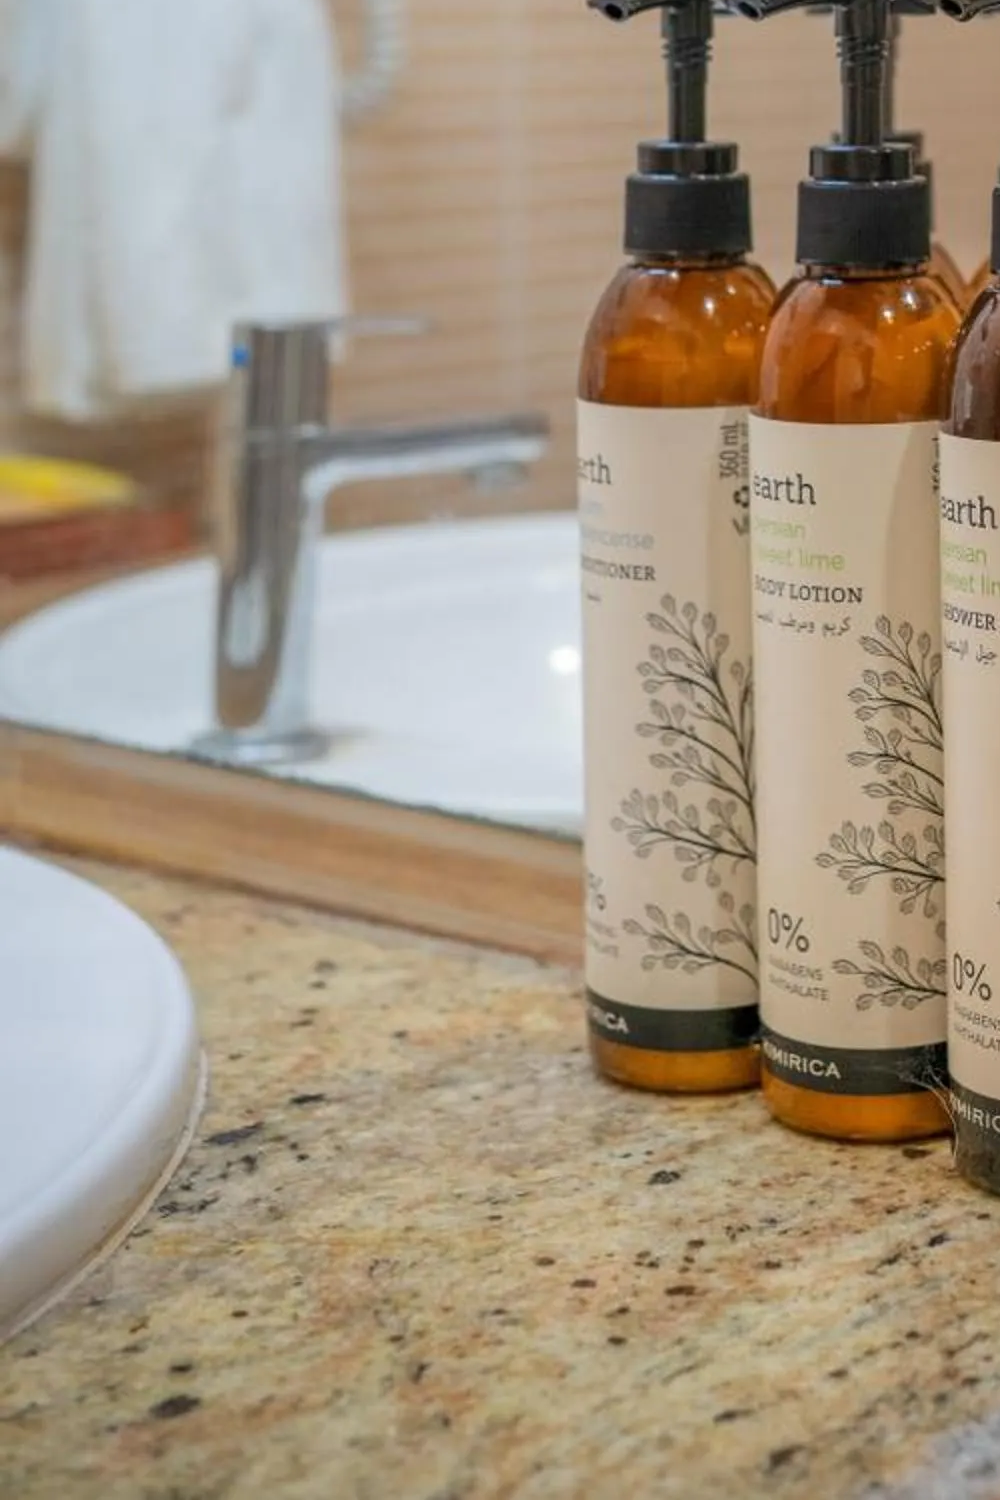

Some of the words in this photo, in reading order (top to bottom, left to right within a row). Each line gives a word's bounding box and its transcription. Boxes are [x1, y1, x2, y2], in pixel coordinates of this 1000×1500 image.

[719, 450, 739, 480] 360
[799, 548, 846, 571] lime
[789, 583, 863, 604] LOTION
[768, 908, 810, 953] 0%
[953, 952, 992, 1001] 0%
